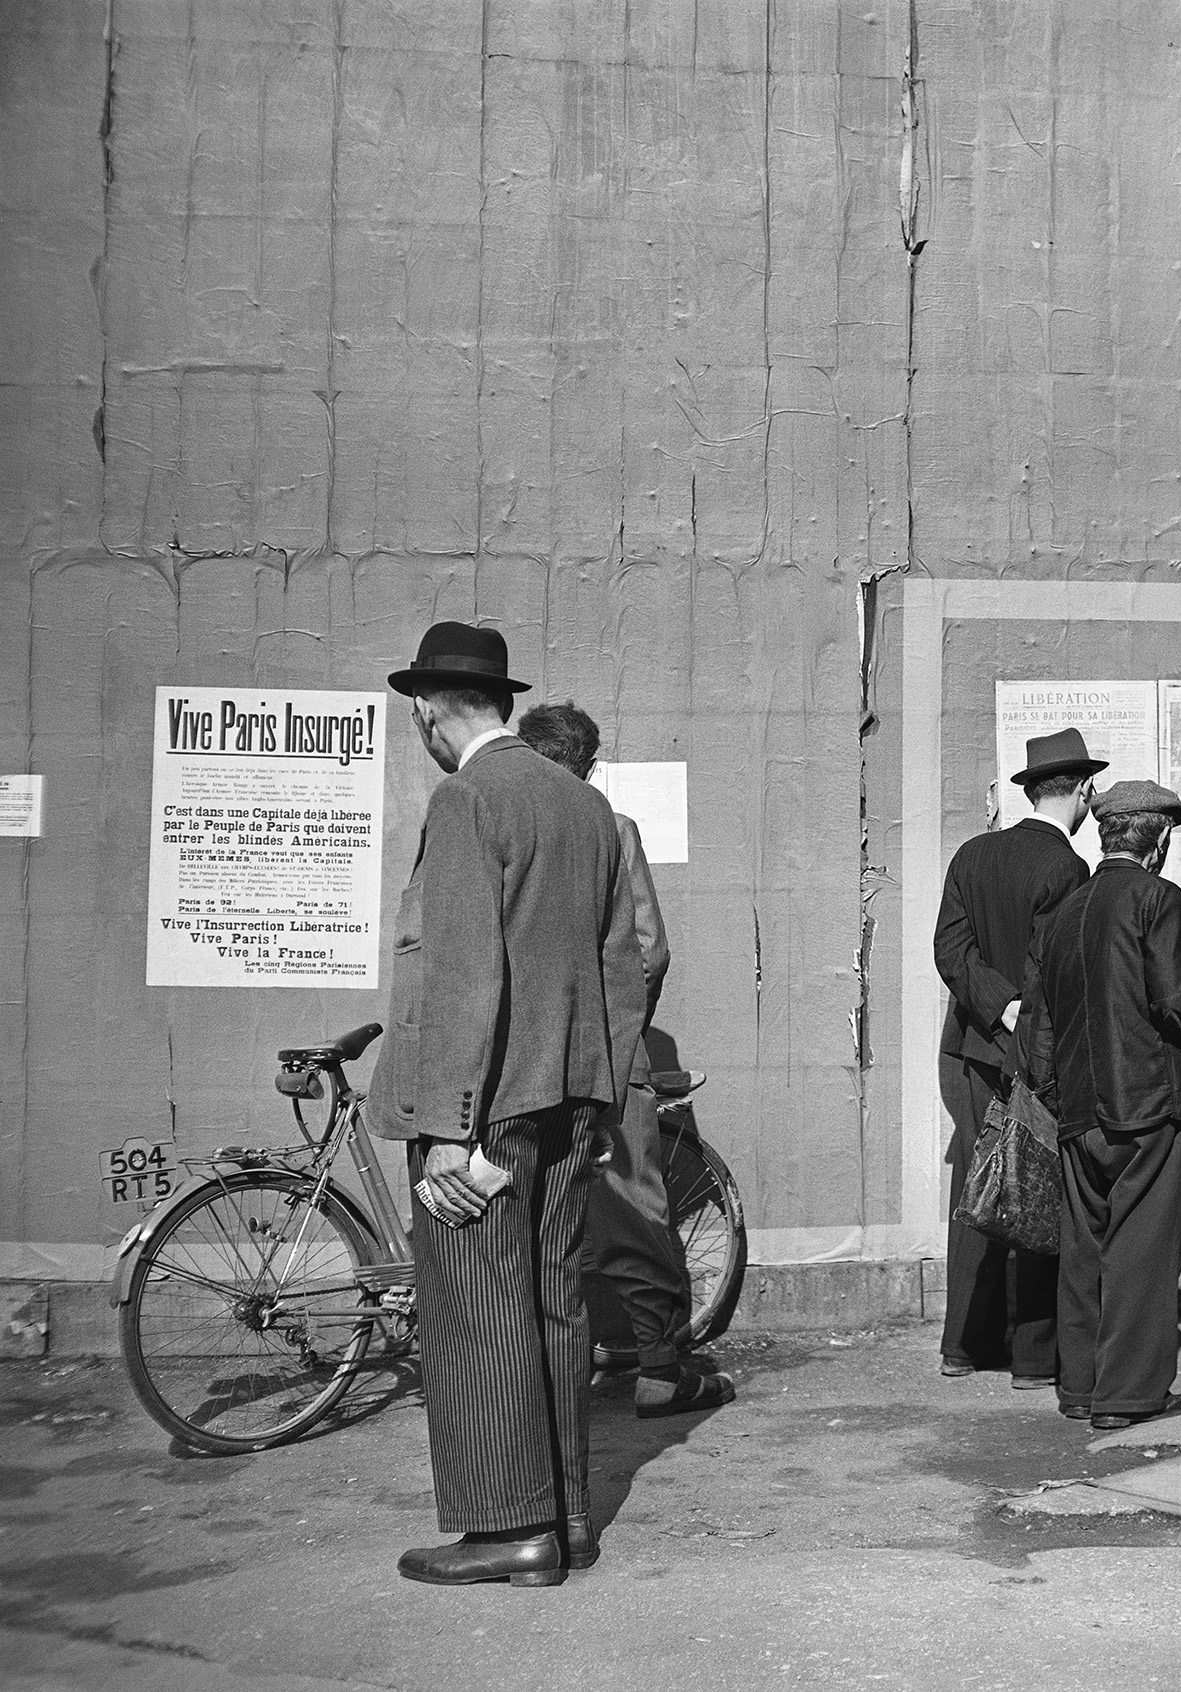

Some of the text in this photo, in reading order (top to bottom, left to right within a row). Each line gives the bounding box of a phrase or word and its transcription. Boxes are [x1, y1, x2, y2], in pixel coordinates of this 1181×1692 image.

[1022, 691, 1110, 705] LIBÉRATION
[1002, 712, 1027, 721] PARIS
[1030, 711, 1040, 721] SE
[1043, 711, 1058, 721] BAT
[1062, 711, 1084, 721] POUR
[1088, 711, 1098, 720] SA
[168, 698, 213, 751] Vive
[219, 700, 277, 752] Paris
[164, 805, 193, 816] C'est
[195, 807, 224, 817] dans
[227, 809, 249, 818] une
[252, 808, 301, 820] Capitale
[304, 809, 328, 821] déjà
[163, 820, 371, 835] par le Peuple de Paris que doivent
[163, 834, 371, 847] entrer les blindés Américains.
[216, 849, 226, 857] de
[229, 849, 237, 857] la
[240, 849, 269, 857] France
[160, 918, 191, 929] Vive
[196, 920, 284, 931] l'Insurrection
[190, 932, 222, 943] Vive
[216, 946, 249, 957] Vive
[258, 947, 270, 958] la
[245, 960, 260, 969] Les
[321, 962, 368, 970] Parisiennes
[110, 1146, 167, 1174] 504
